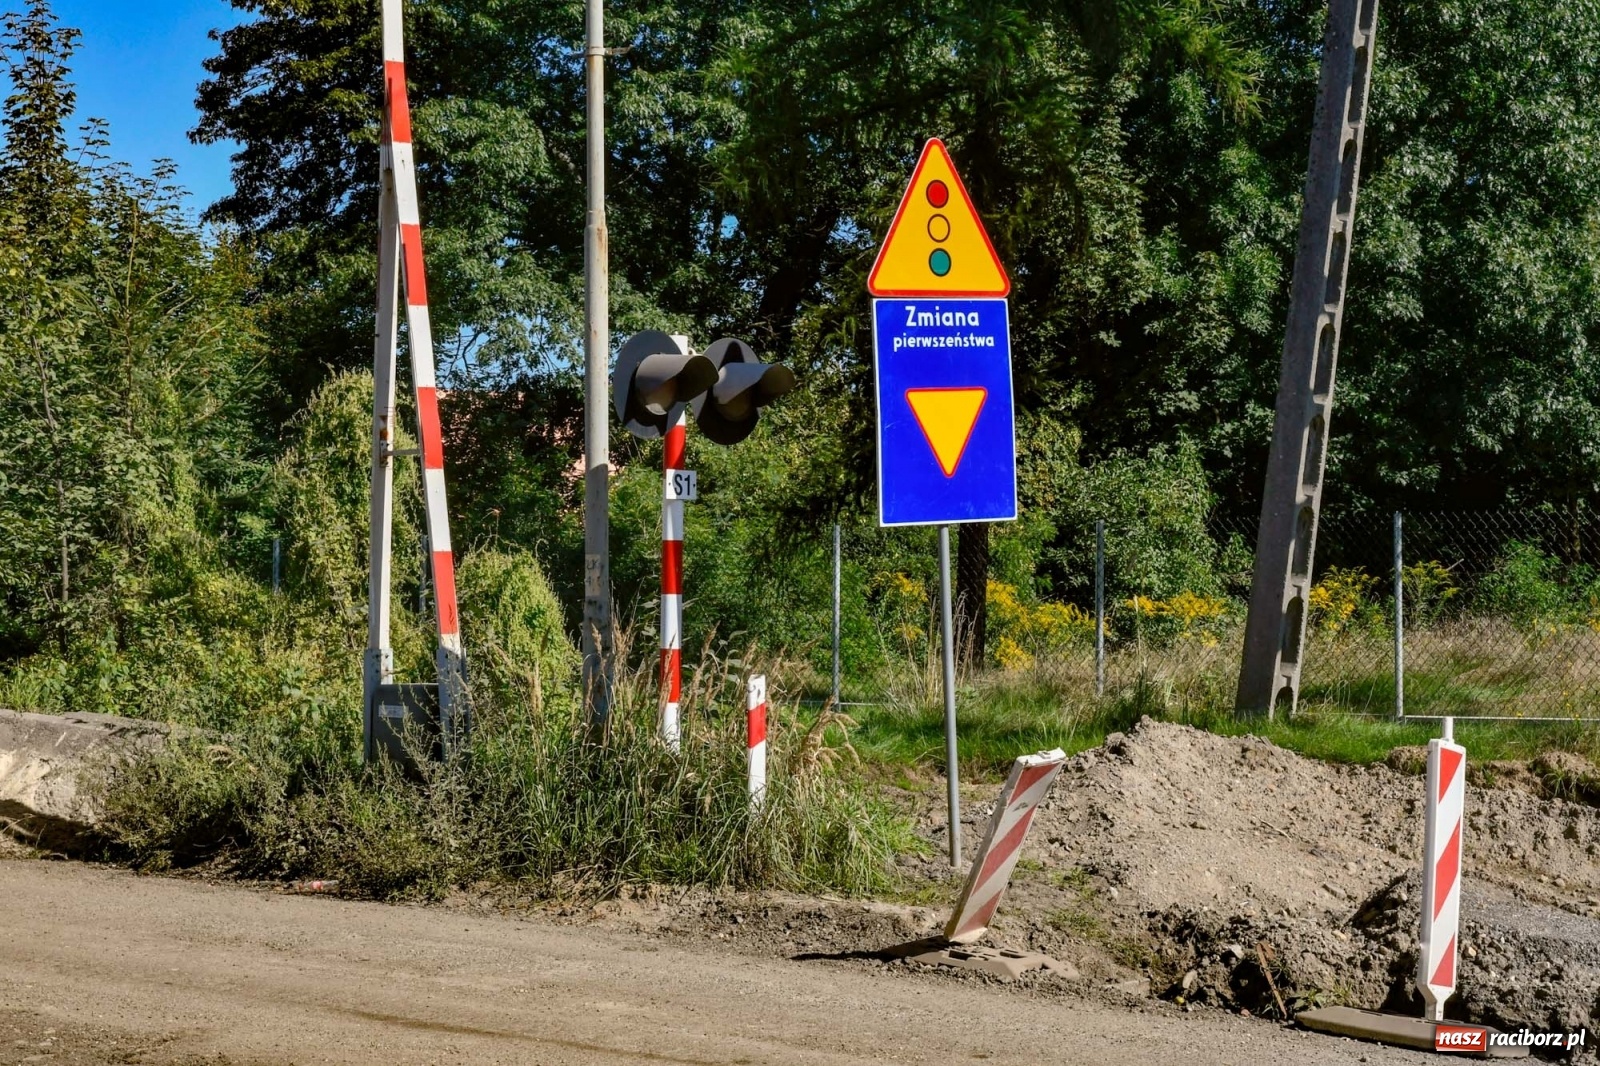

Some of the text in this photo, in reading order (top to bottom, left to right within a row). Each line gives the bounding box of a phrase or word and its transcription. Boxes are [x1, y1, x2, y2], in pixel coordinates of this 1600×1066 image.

[905, 305, 980, 327] Zmiana
[893, 332, 995, 352] pierwszeństwa
[674, 473, 691, 496] S1
